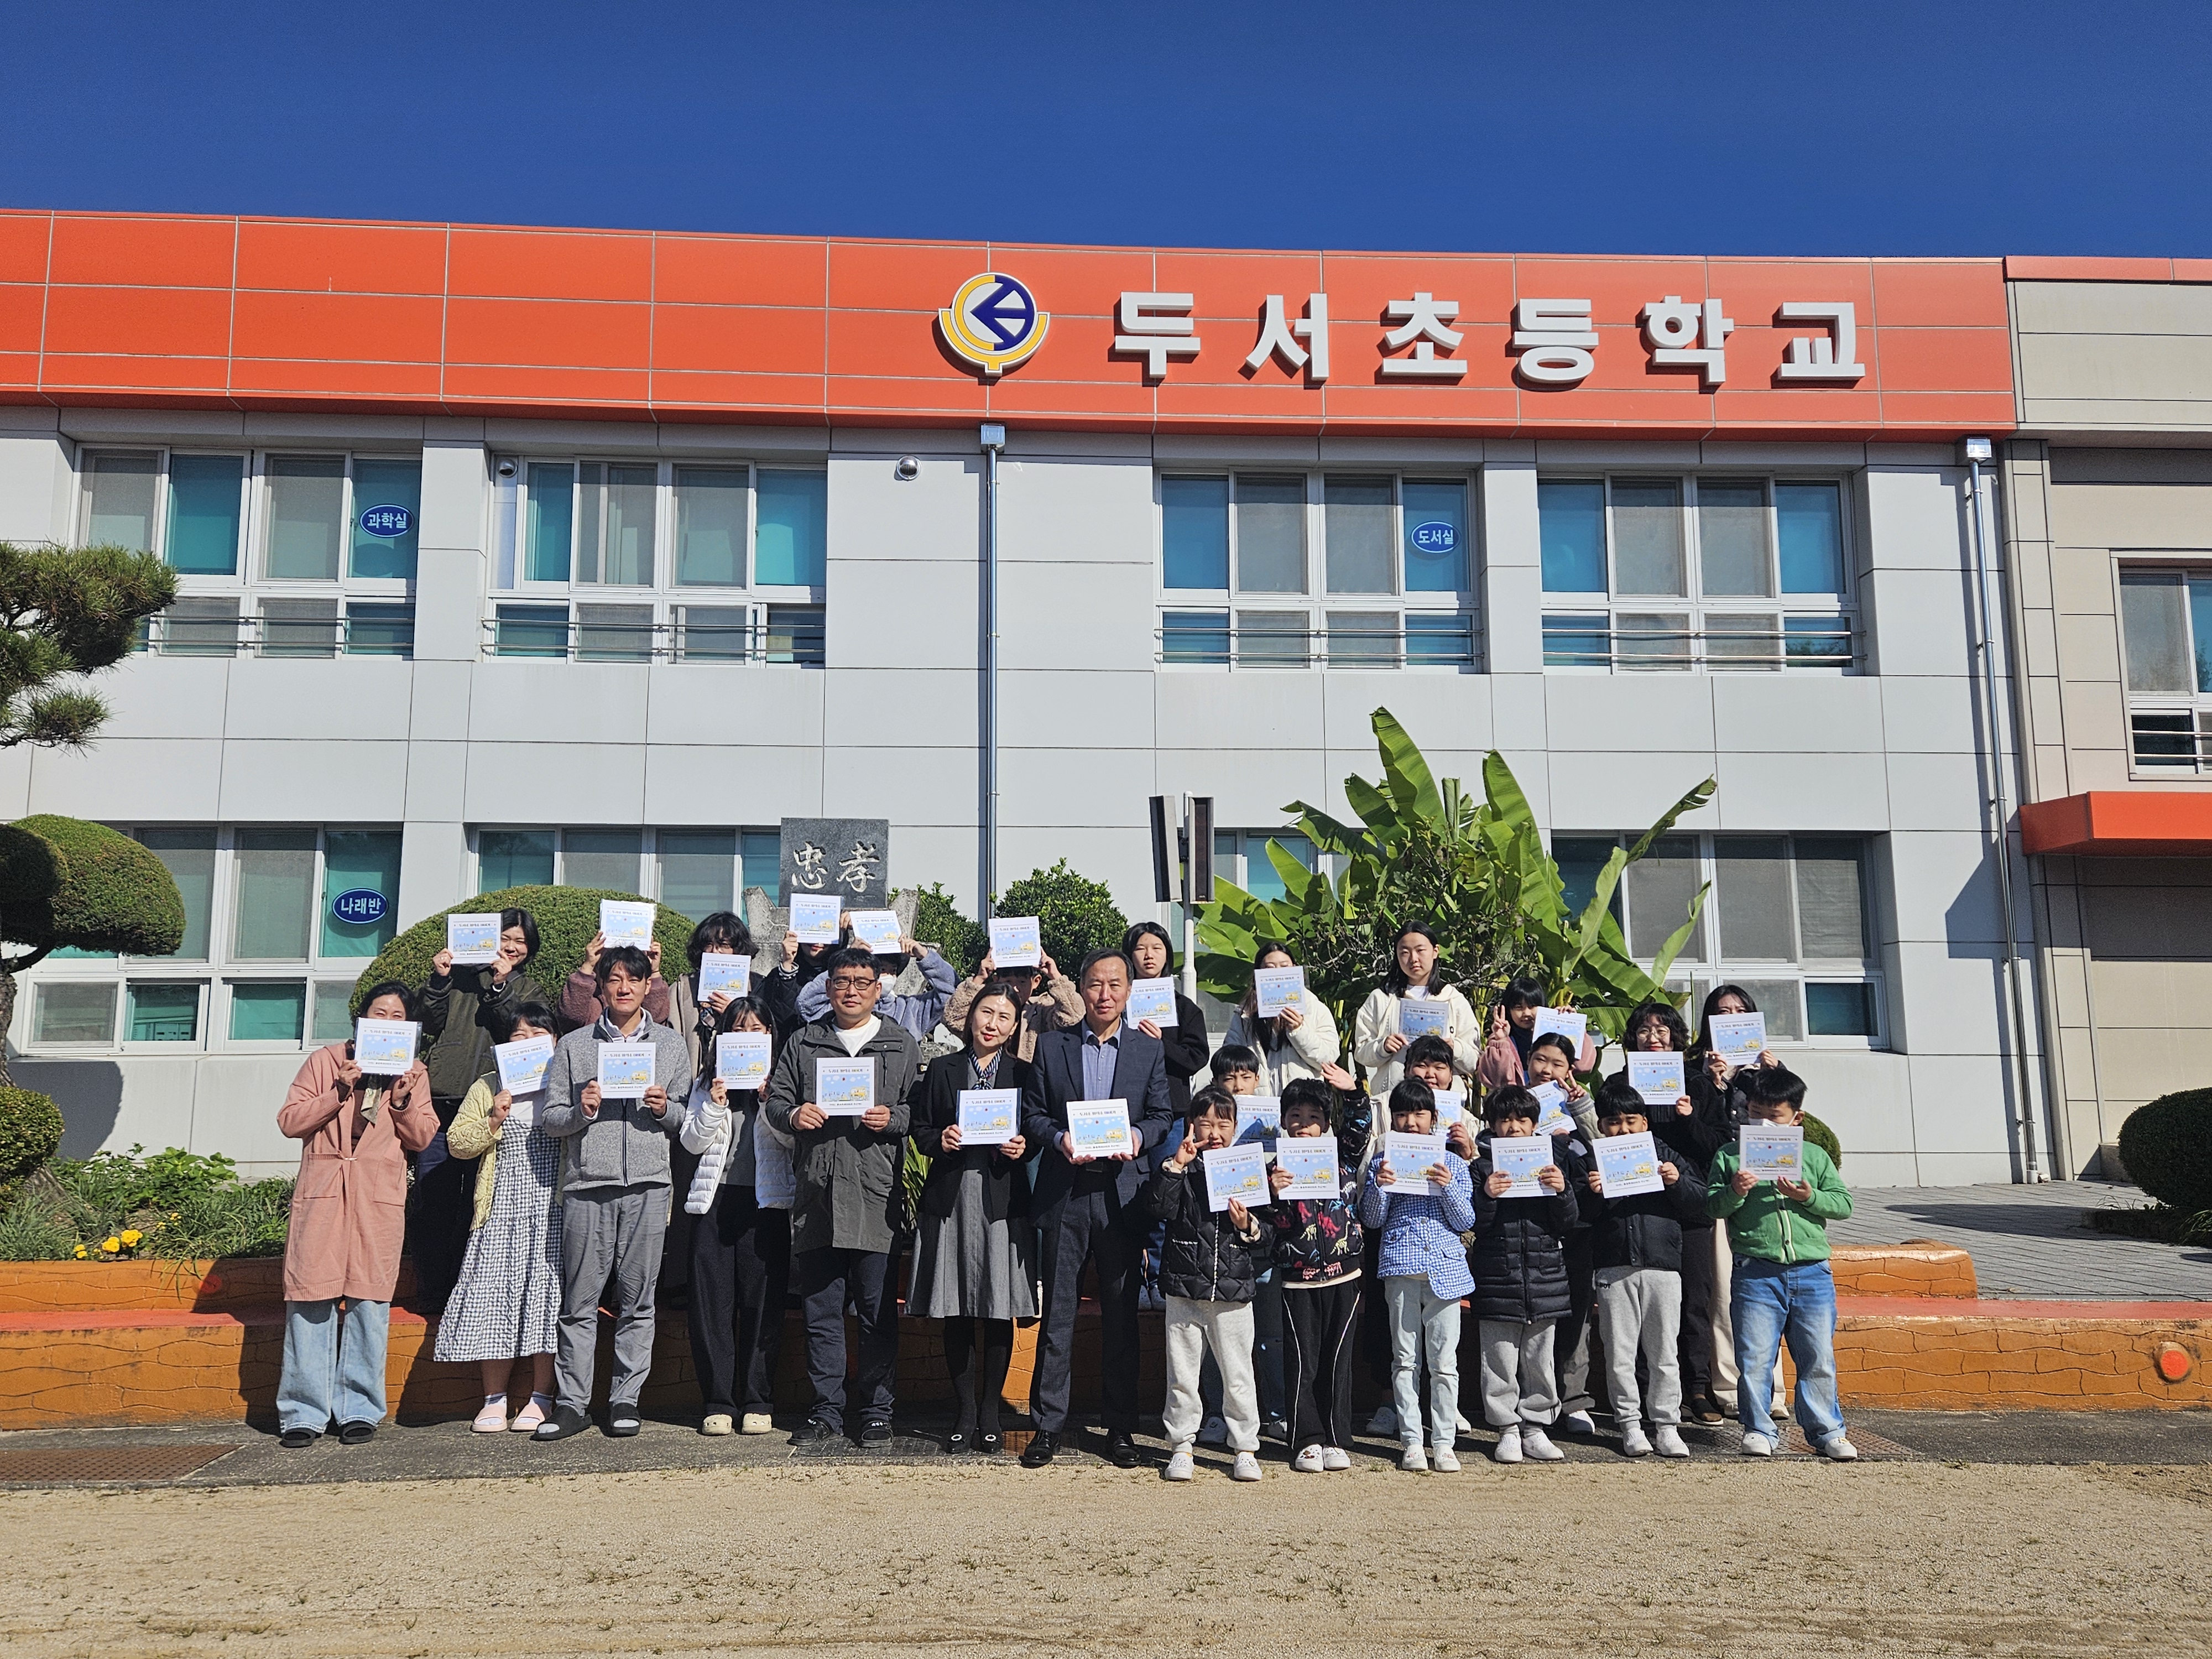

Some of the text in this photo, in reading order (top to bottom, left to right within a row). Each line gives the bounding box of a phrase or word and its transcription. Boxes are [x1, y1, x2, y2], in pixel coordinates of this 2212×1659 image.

[1115, 291, 1866, 386] 두서초등학교
[367, 512, 407, 529] 과학실
[1418, 529, 1454, 545] 도서실
[791, 840, 880, 893] 忠孝
[341, 898, 382, 915] 나래반
